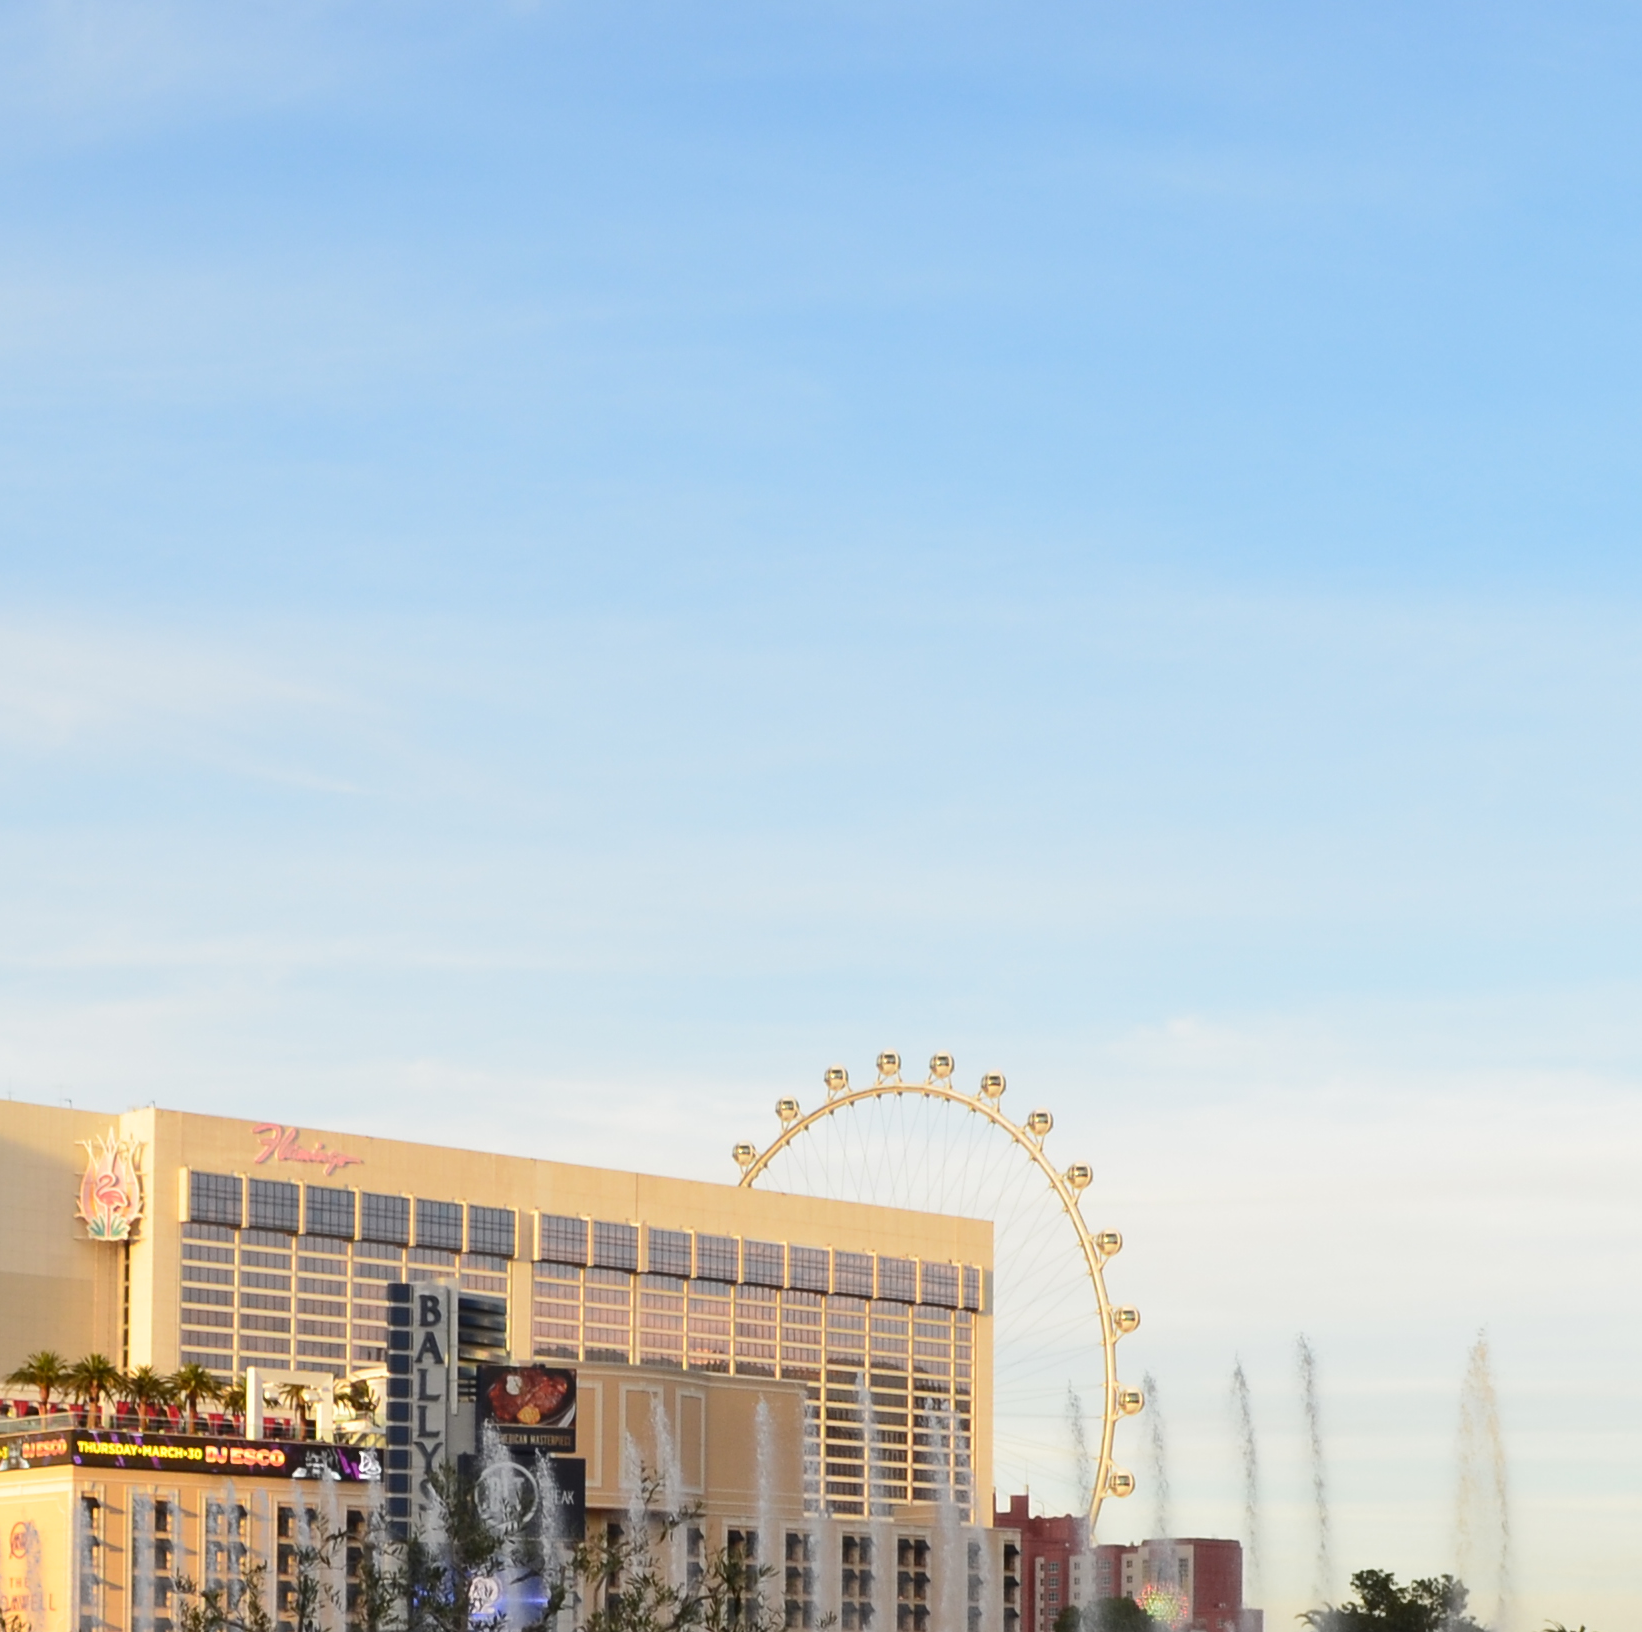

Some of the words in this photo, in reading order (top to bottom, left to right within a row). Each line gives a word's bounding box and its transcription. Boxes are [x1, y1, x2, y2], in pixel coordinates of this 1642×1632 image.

[252, 1123, 364, 1176] Flamingo
[36, 1439, 68, 1458] ESCO
[498, 1433, 528, 1444] MERICAN
[205, 1445, 228, 1464] DJ
[230, 1447, 285, 1467] ESCO
